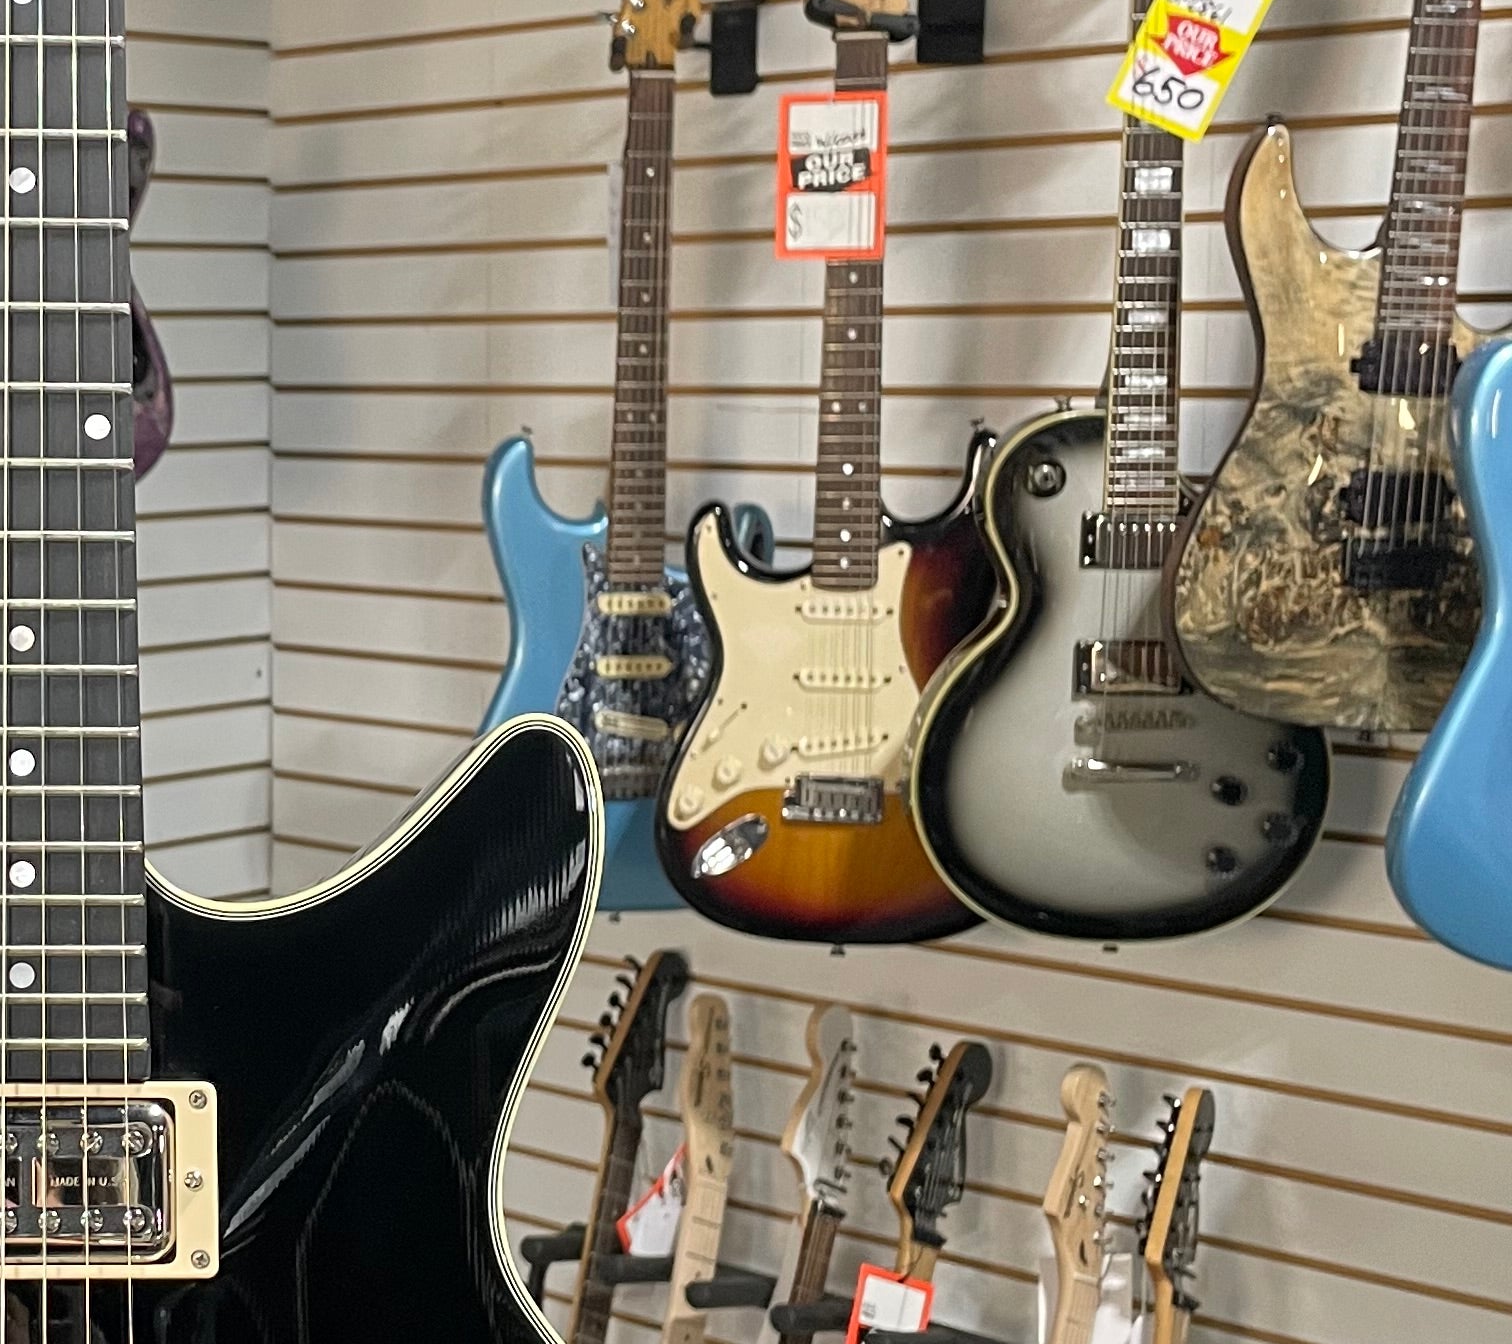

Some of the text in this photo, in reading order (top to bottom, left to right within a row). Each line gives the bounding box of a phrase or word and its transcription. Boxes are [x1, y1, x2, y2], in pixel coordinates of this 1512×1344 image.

[1176, 19, 1218, 50] OUR
[1163, 32, 1219, 68] PRICE
[805, 148, 855, 172] OUR
[797, 162, 867, 191] PRICE
[49, 1176, 81, 1188] MADE
